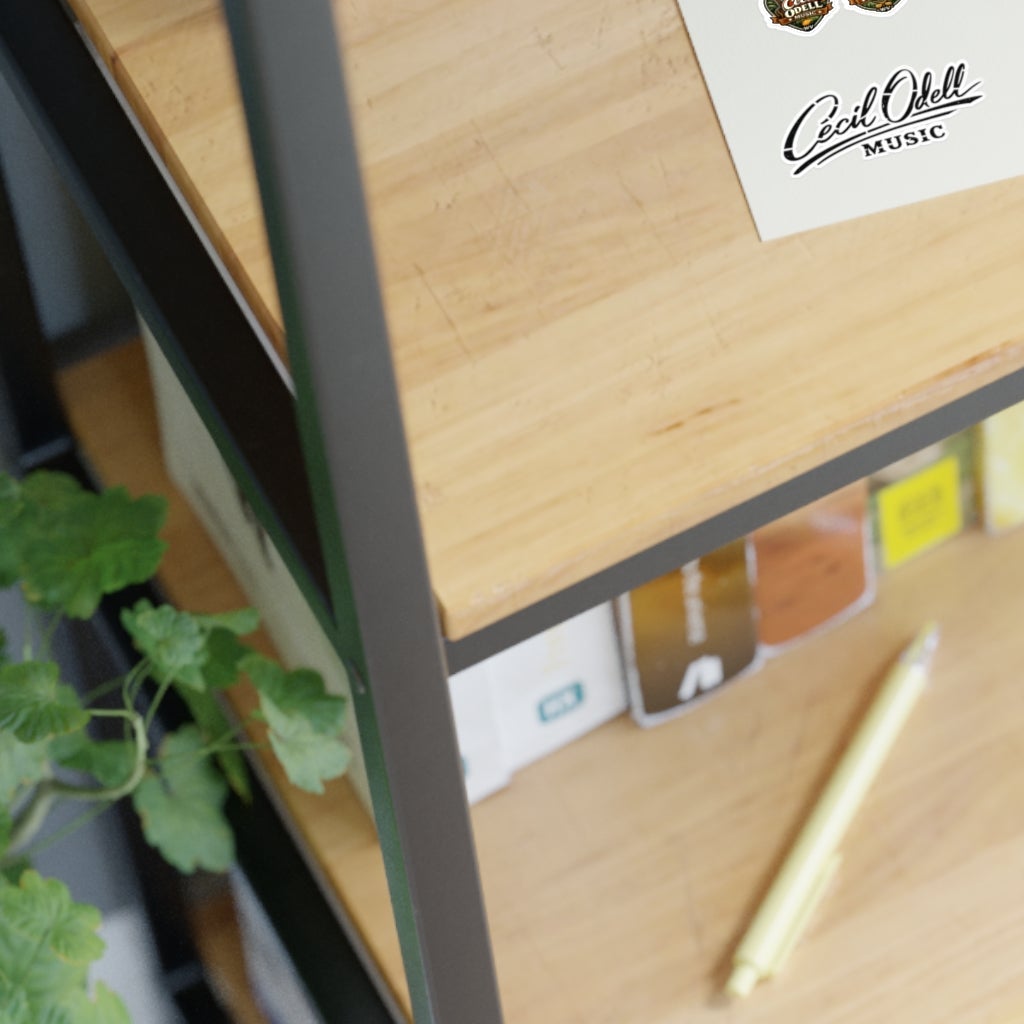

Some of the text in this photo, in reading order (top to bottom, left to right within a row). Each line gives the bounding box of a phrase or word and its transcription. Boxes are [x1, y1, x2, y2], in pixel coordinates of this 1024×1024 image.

[784, 0, 824, 18] ODELL
[793, 9, 817, 20] MUSIC
[783, 62, 982, 162] Cecil Odell
[861, 124, 946, 157] MUSIC
